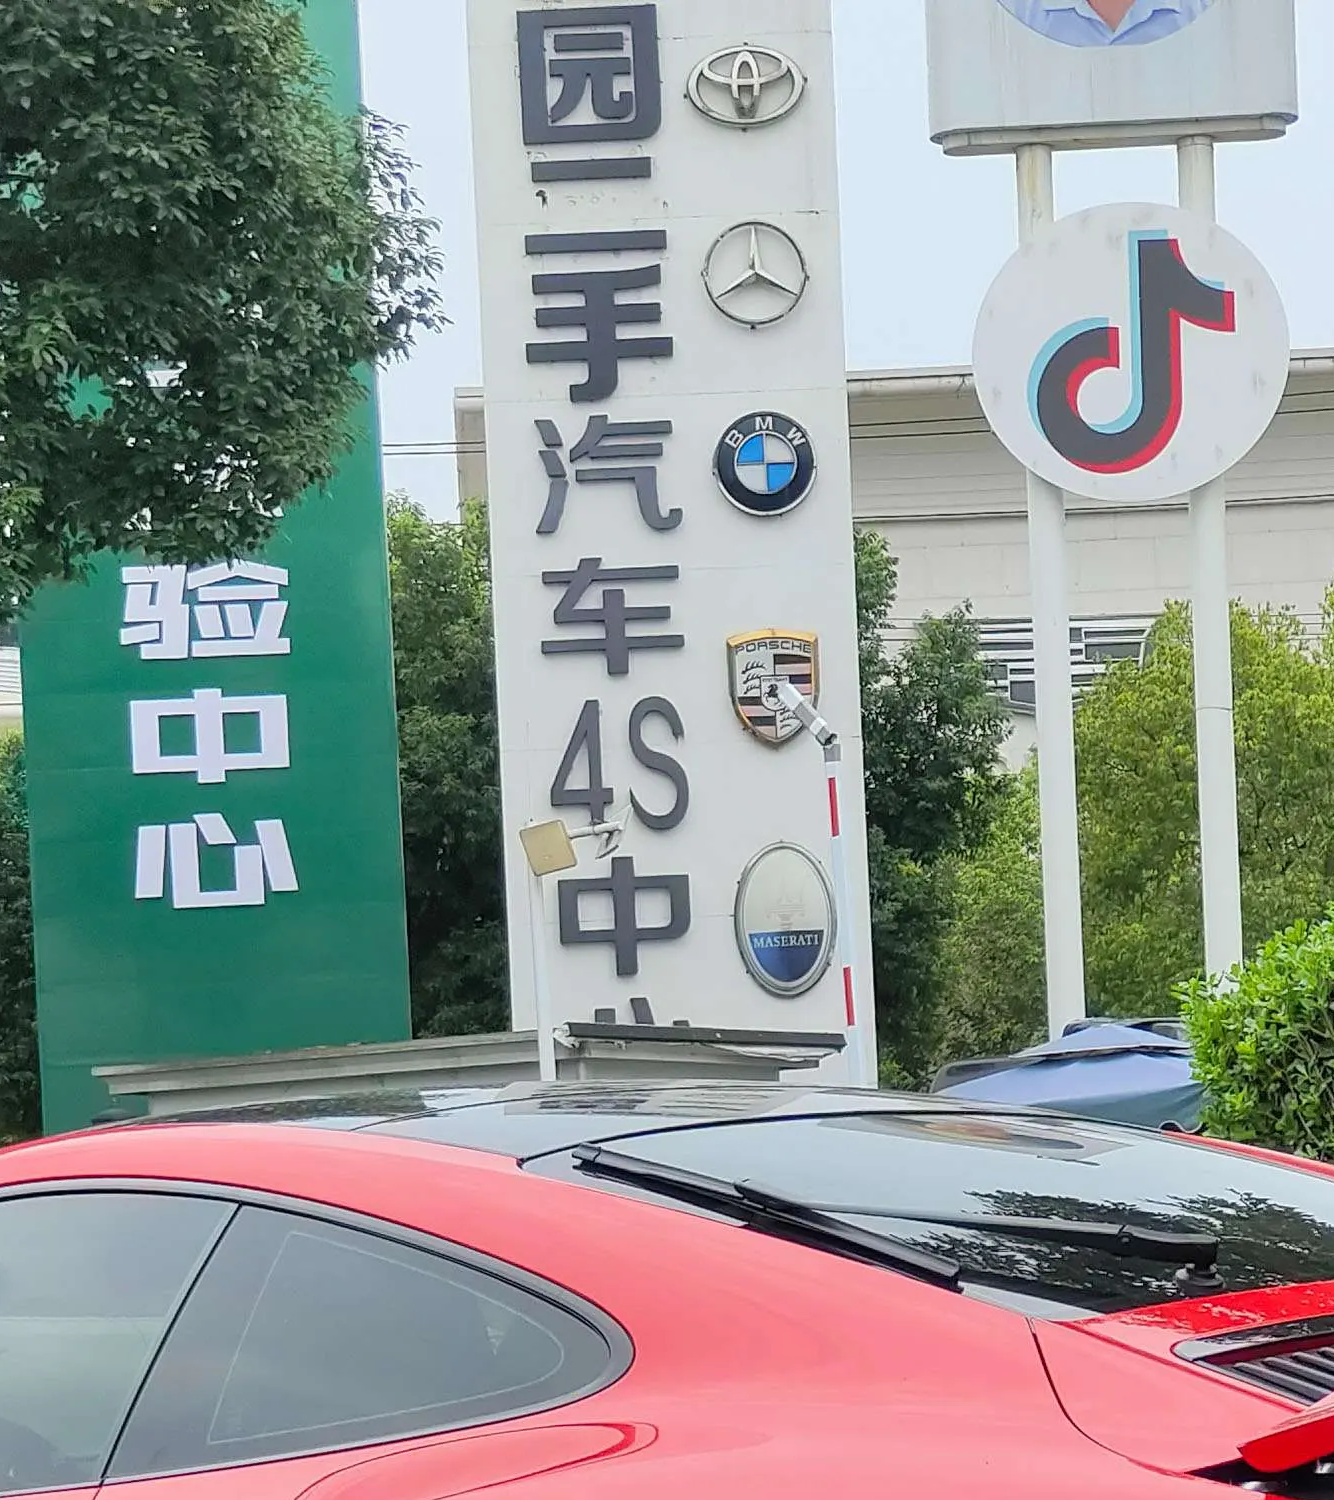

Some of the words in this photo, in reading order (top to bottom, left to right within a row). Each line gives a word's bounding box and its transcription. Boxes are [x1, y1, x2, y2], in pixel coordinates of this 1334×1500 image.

[724, 415, 806, 448] BMW
[516, 4, 691, 1027] 园二手汽车4S中
[735, 640, 811, 655] PORSCHE
[120, 560, 299, 909] 验中心
[752, 934, 820, 948] MASERATI
